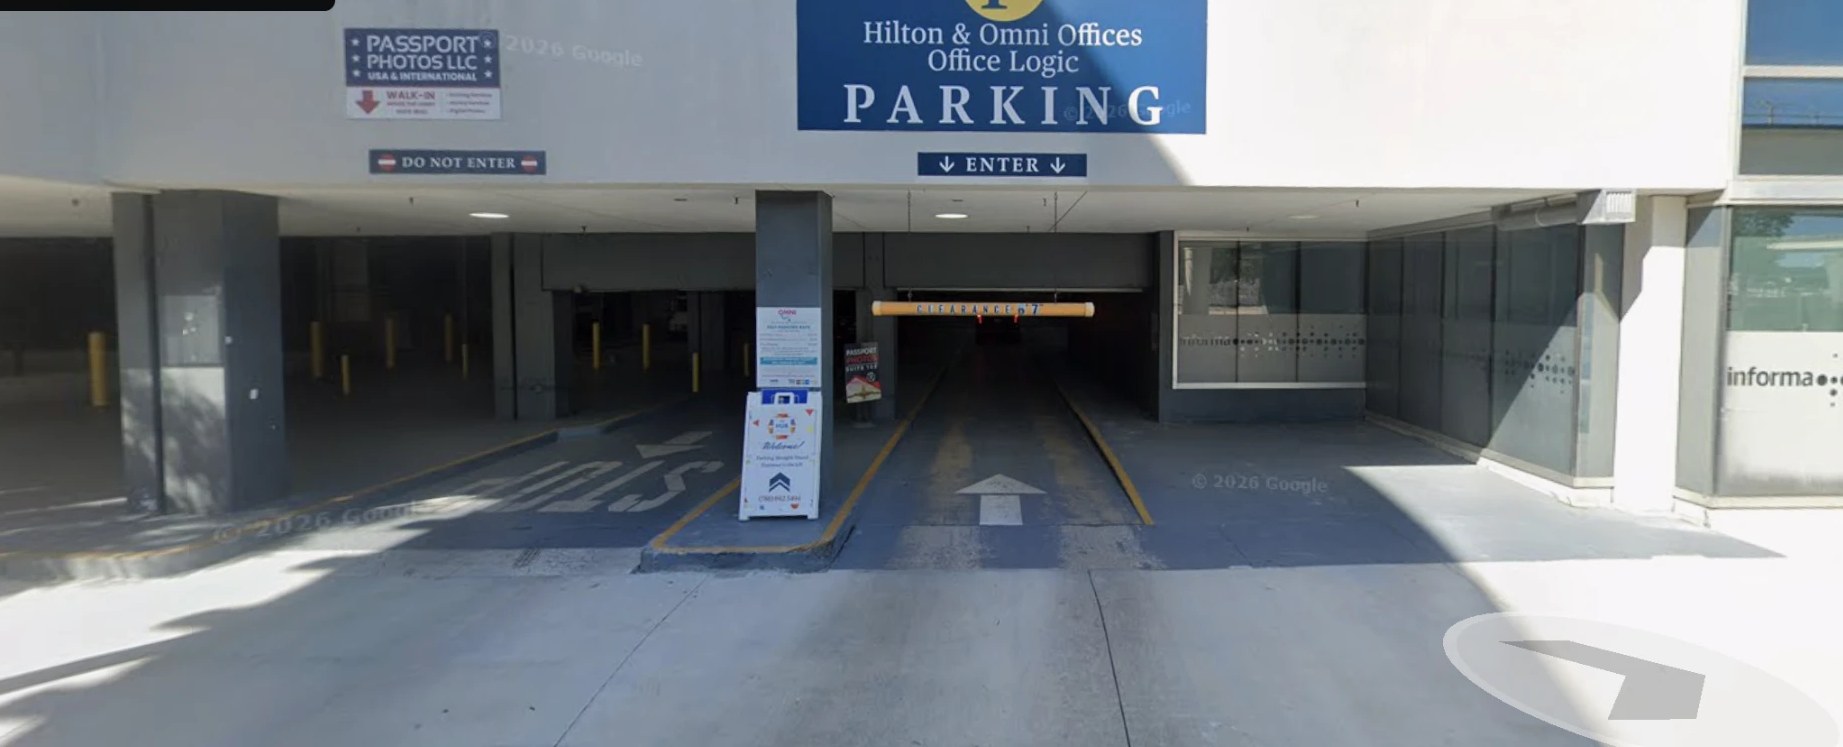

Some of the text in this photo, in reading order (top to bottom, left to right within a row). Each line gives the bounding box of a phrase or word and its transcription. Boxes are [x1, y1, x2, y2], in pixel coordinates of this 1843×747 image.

[863, 21, 1143, 46] Hilton & Omni Offices
[366, 35, 480, 53] PASSPORT
[367, 54, 477, 70] PHOTOS LLC
[928, 49, 1079, 78] Office Logic
[368, 72, 477, 82] USA & INTERNATIONAL
[386, 91, 435, 100] WALK-IN
[843, 84, 1163, 126] PARKING
[402, 157, 516, 169] DO NOT ENTER
[966, 157, 1039, 173] ENTER
[1727, 366, 1813, 386] informa
